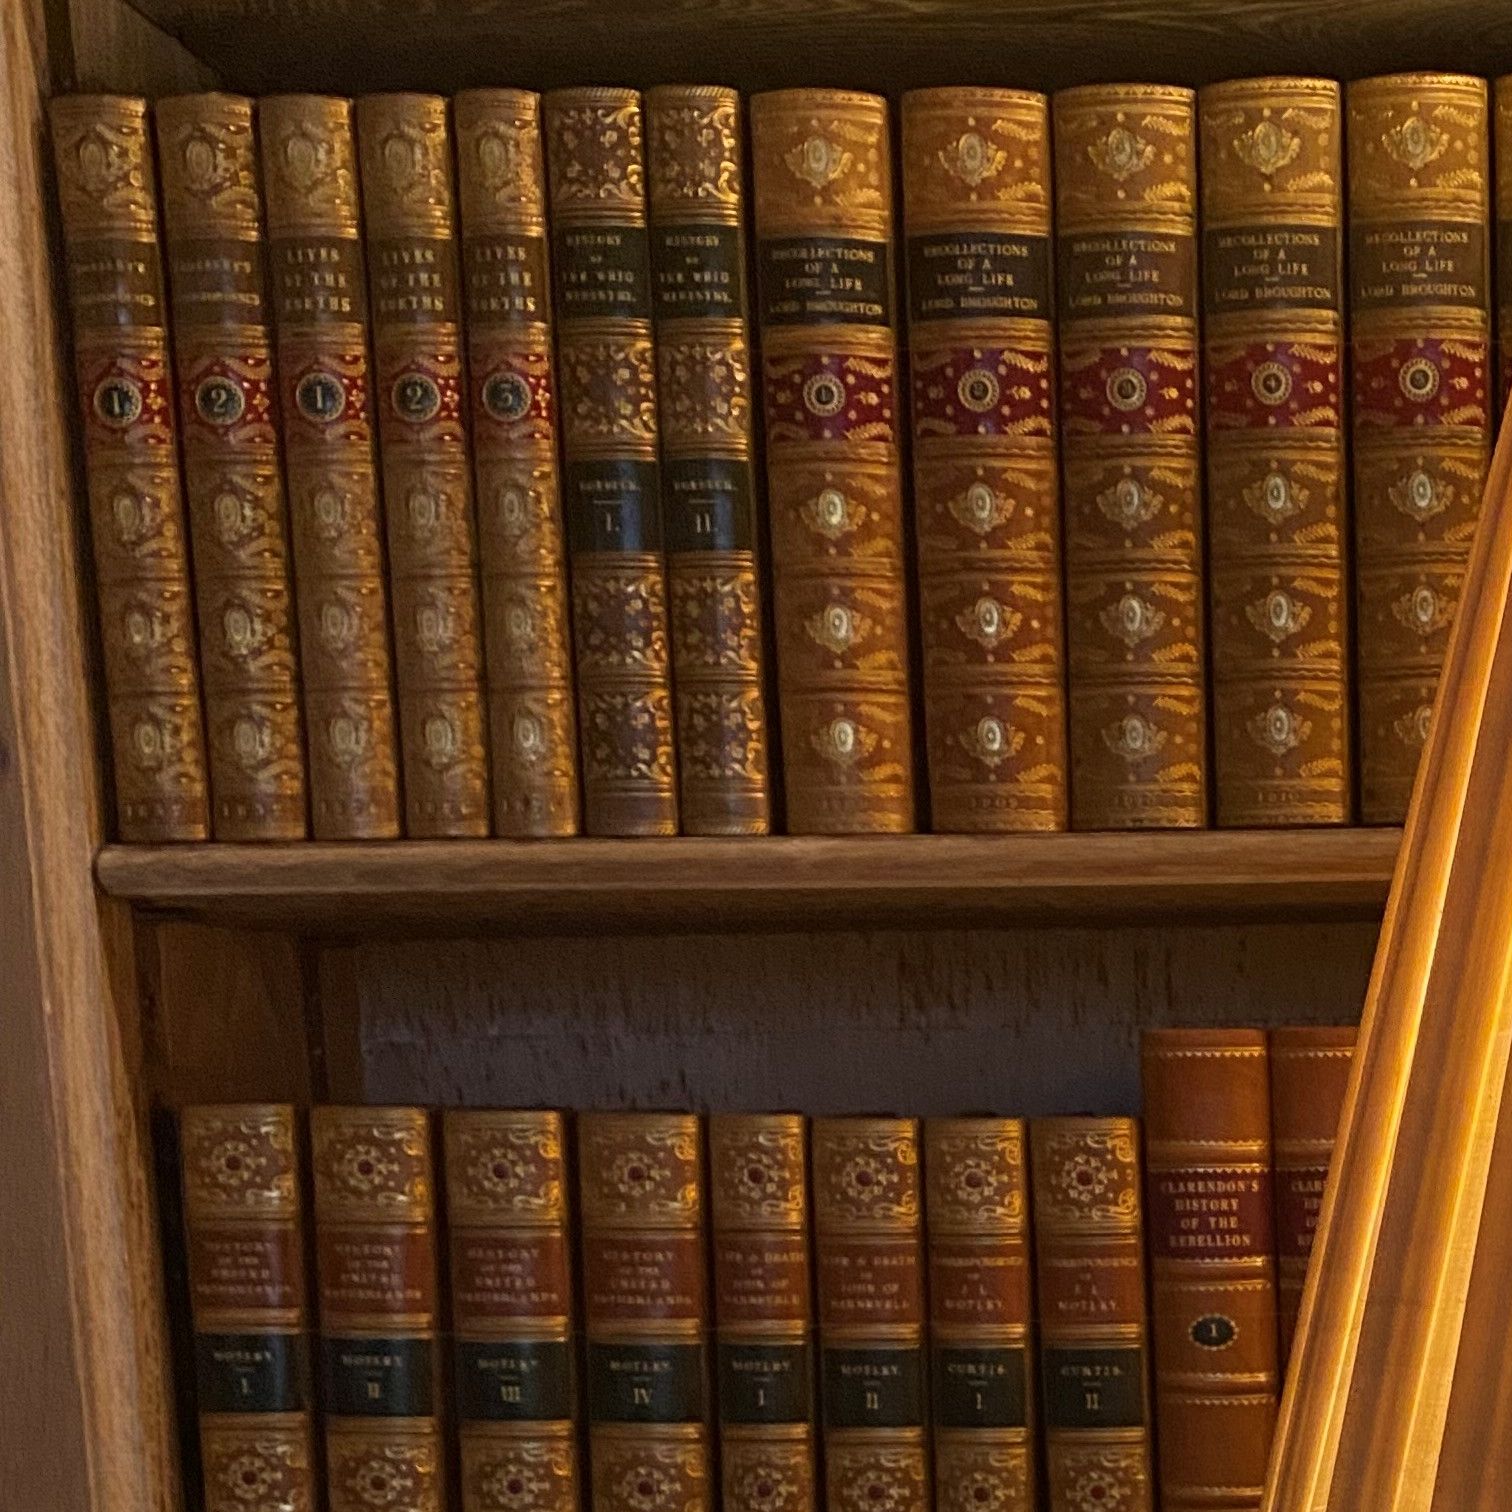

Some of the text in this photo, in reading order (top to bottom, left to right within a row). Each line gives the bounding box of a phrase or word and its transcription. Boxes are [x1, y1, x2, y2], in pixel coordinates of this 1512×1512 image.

[1219, 232, 1320, 247] RECOLLECTIONS
[1365, 230, 1471, 245] RECOLLECTIONS
[475, 245, 527, 262] LIVES
[923, 243, 1029, 258] RECOLLECTIONS
[1072, 239, 1177, 254] RECOLLECTIONS
[1252, 246, 1287, 260] OF A
[1402, 244, 1438, 258] OF A
[286, 246, 341, 264] LIVES
[382, 248, 435, 265] LIVES
[1128, 253, 1139, 266] A
[829, 261, 840, 274] A
[980, 257, 993, 270] A
[1277, 262, 1310, 277] LIFE
[1381, 258, 1456, 273] LONG LIFE
[310, 271, 347, 288] THE
[407, 272, 442, 288] THE
[498, 271, 532, 288] THE
[981, 272, 1016, 287] LIFE
[1128, 268, 1161, 283] LIFE
[829, 277, 864, 292] LIFE
[1401, 283, 1477, 299] BROUGHTON
[1254, 285, 1332, 300] BROUGHTON
[112, 391, 122, 414] 1
[211, 388, 228, 413] 2
[313, 386, 325, 410] 1
[405, 386, 423, 411] 2
[1159, 1180, 1260, 1194] CLARENDON'S
[1174, 1198, 1240, 1212] HISTORY
[1180, 1216, 1239, 1230] OF THE
[1169, 1234, 1252, 1248] REBELLION
[499, 1384, 521, 1403] III
[632, 1387, 653, 1406] IV
[758, 1387, 766, 1408] I
[865, 1391, 880, 1411] II
[975, 1391, 983, 1411] I
[1085, 1391, 1100, 1411] II
